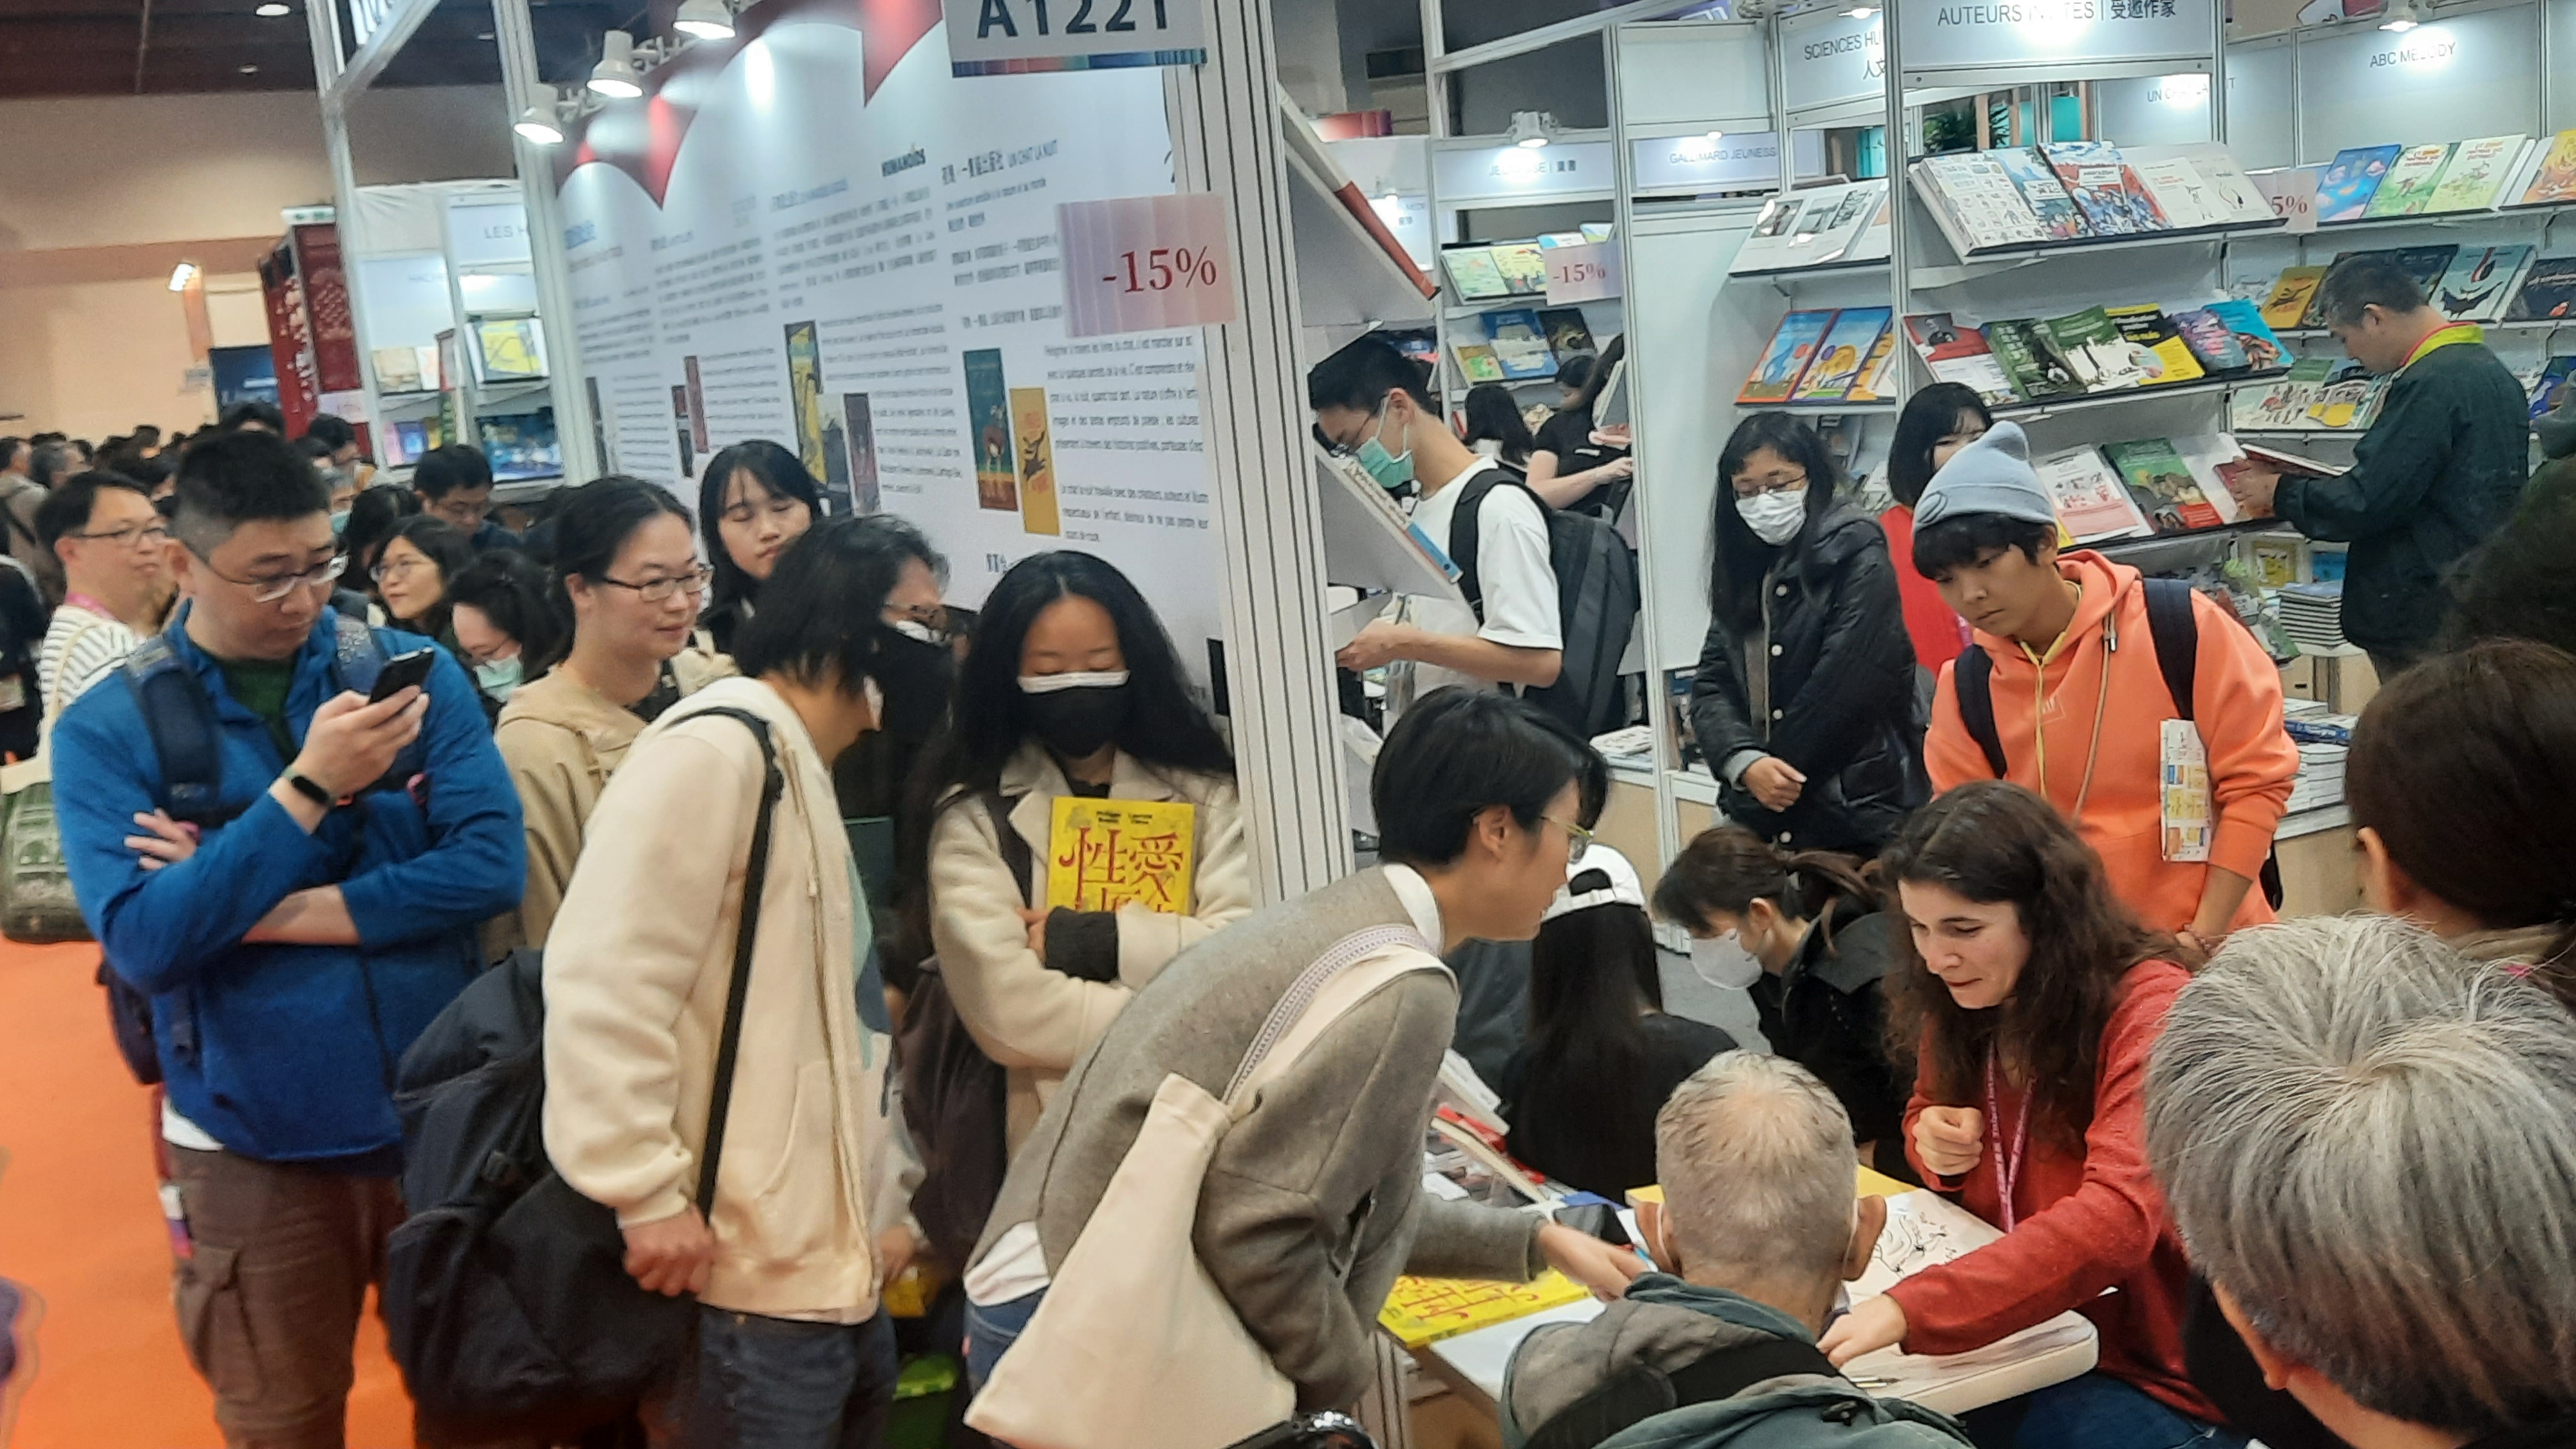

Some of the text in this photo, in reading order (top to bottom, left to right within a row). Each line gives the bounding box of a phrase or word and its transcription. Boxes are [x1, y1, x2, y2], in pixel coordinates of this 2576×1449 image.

[977, 0, 1168, 39] A1221
[1938, 1, 2094, 26] AUTEURS INTES
[1804, 34, 1862, 60] SCIENCES
[2370, 52, 2396, 68] ABC
[2147, 89, 2162, 102] UN
[1669, 149, 1728, 164] GALLIMARD
[1489, 161, 1546, 176] JEUSE
[484, 226, 513, 239] LES
[1103, 246, 1217, 293] -15%
[1553, 262, 1605, 283] -15%
[1059, 826, 1184, 911] 性愛
